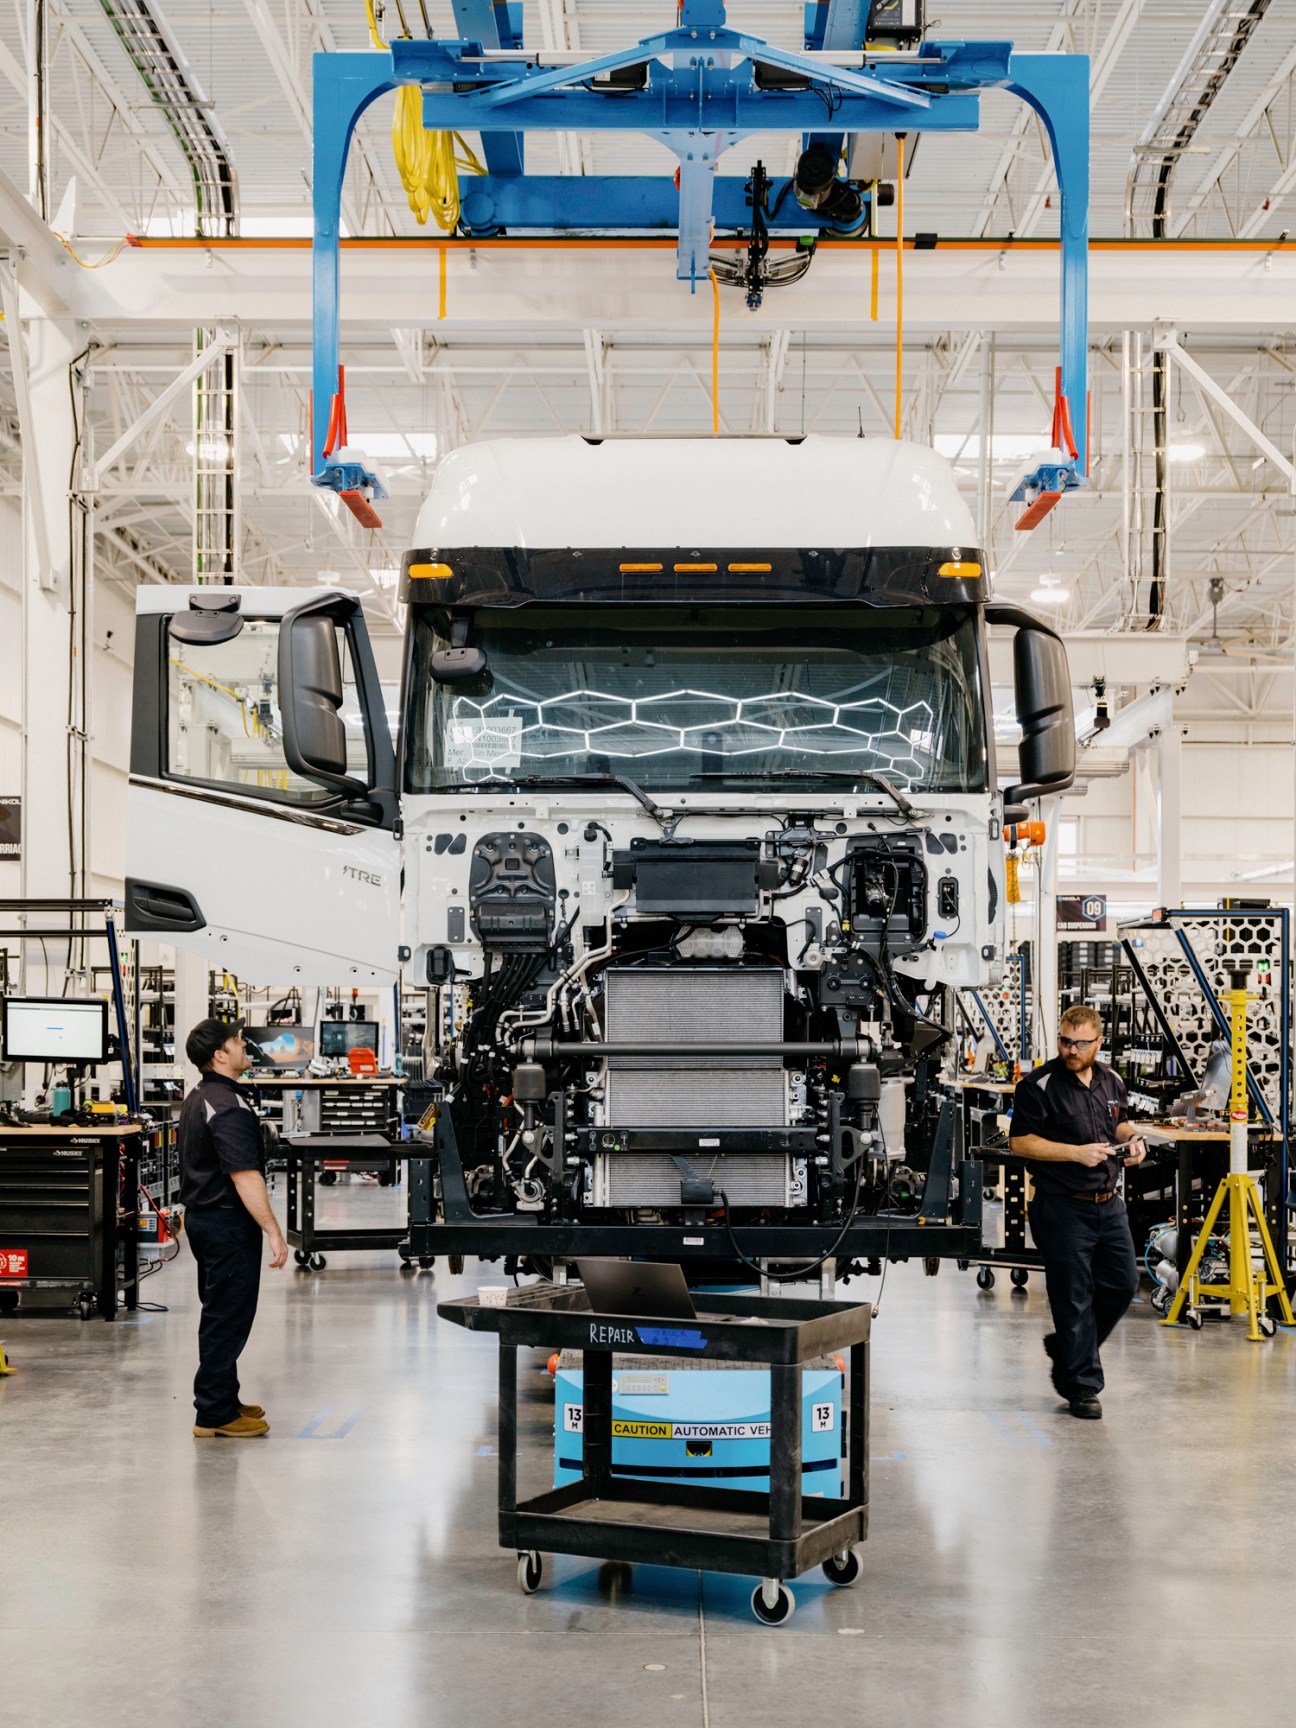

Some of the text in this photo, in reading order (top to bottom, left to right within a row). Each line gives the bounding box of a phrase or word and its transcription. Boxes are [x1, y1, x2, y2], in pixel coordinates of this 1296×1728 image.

[1086, 900, 1102, 916] 09
[590, 1323, 635, 1344] REPAIR
[568, 1407, 582, 1421] 13
[816, 1407, 830, 1420] 13
[614, 1424, 667, 1435] CAUTION
[674, 1426, 746, 1436] AUTOMATIC
